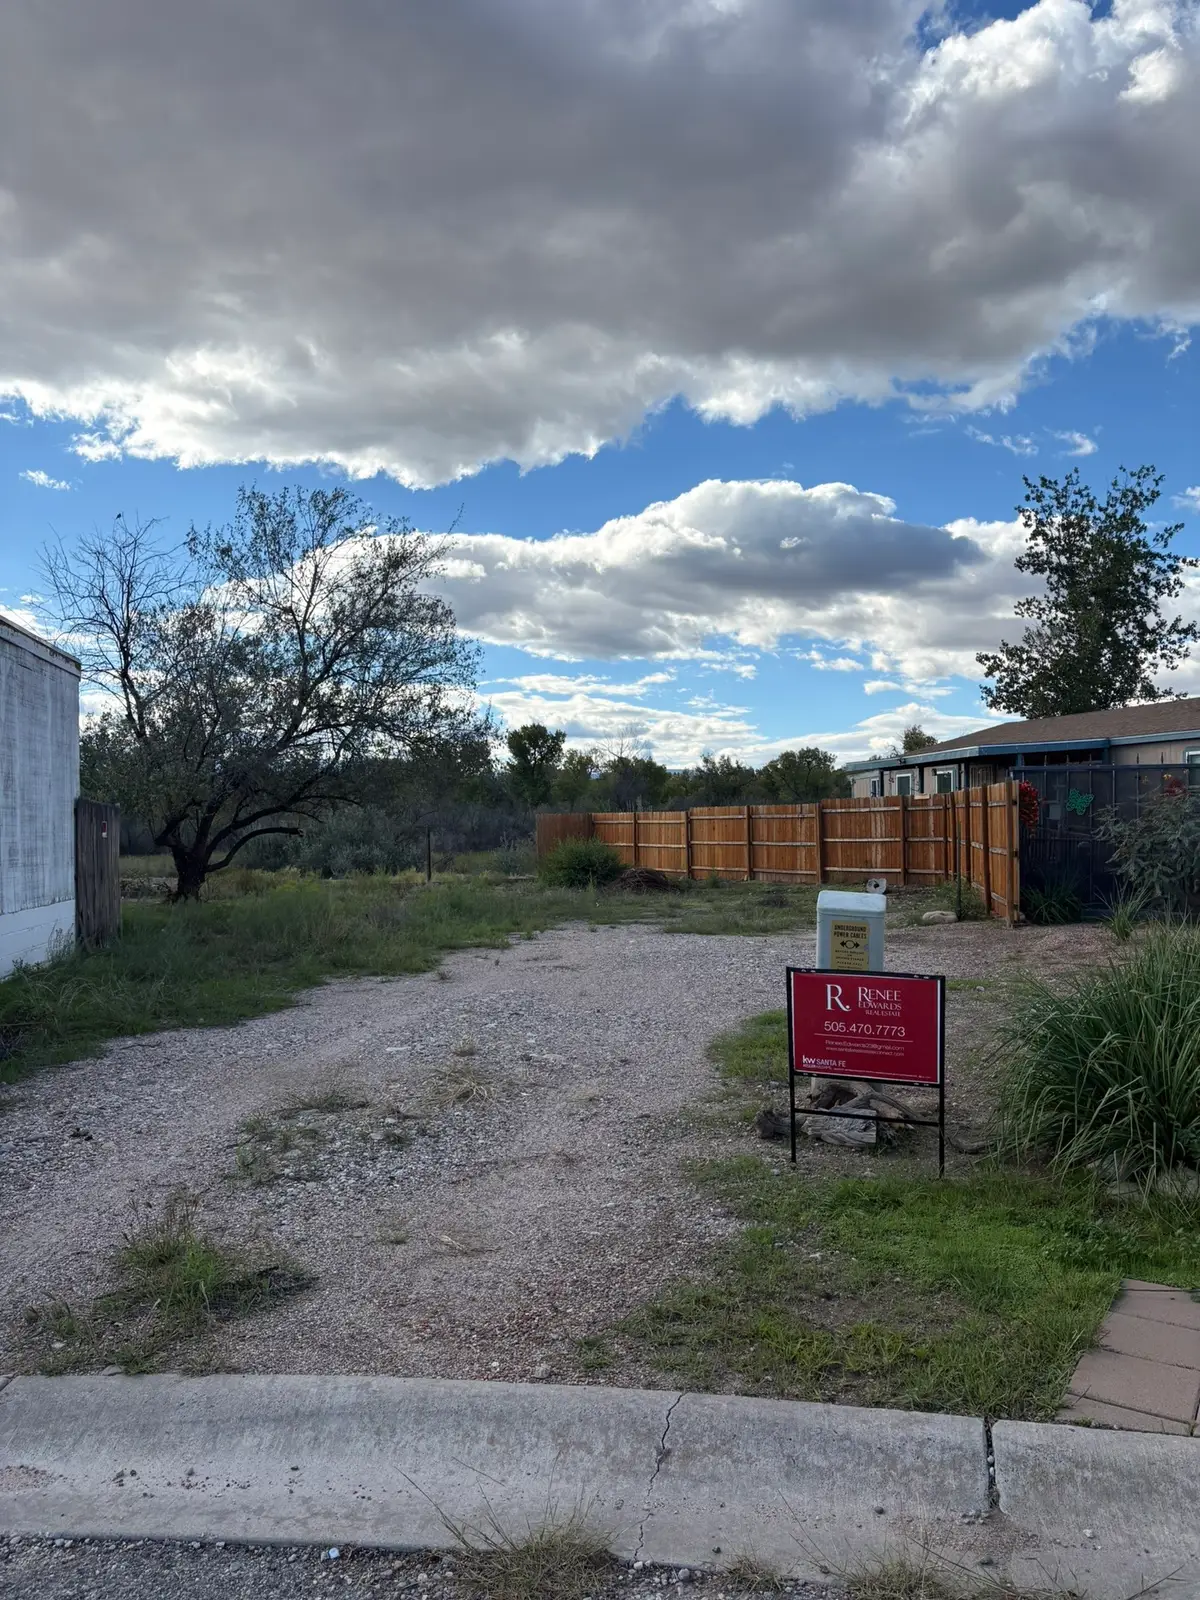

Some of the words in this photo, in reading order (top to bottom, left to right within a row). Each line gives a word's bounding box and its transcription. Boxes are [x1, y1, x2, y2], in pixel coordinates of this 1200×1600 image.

[858, 986, 902, 1002] RENEE
[858, 1001, 902, 1011] EDWARDS
[824, 1021, 905, 1037] 505.470.7773
[802, 1054, 816, 1064] kw
[816, 1058, 837, 1067] SANTA
[838, 1060, 847, 1068] FE
